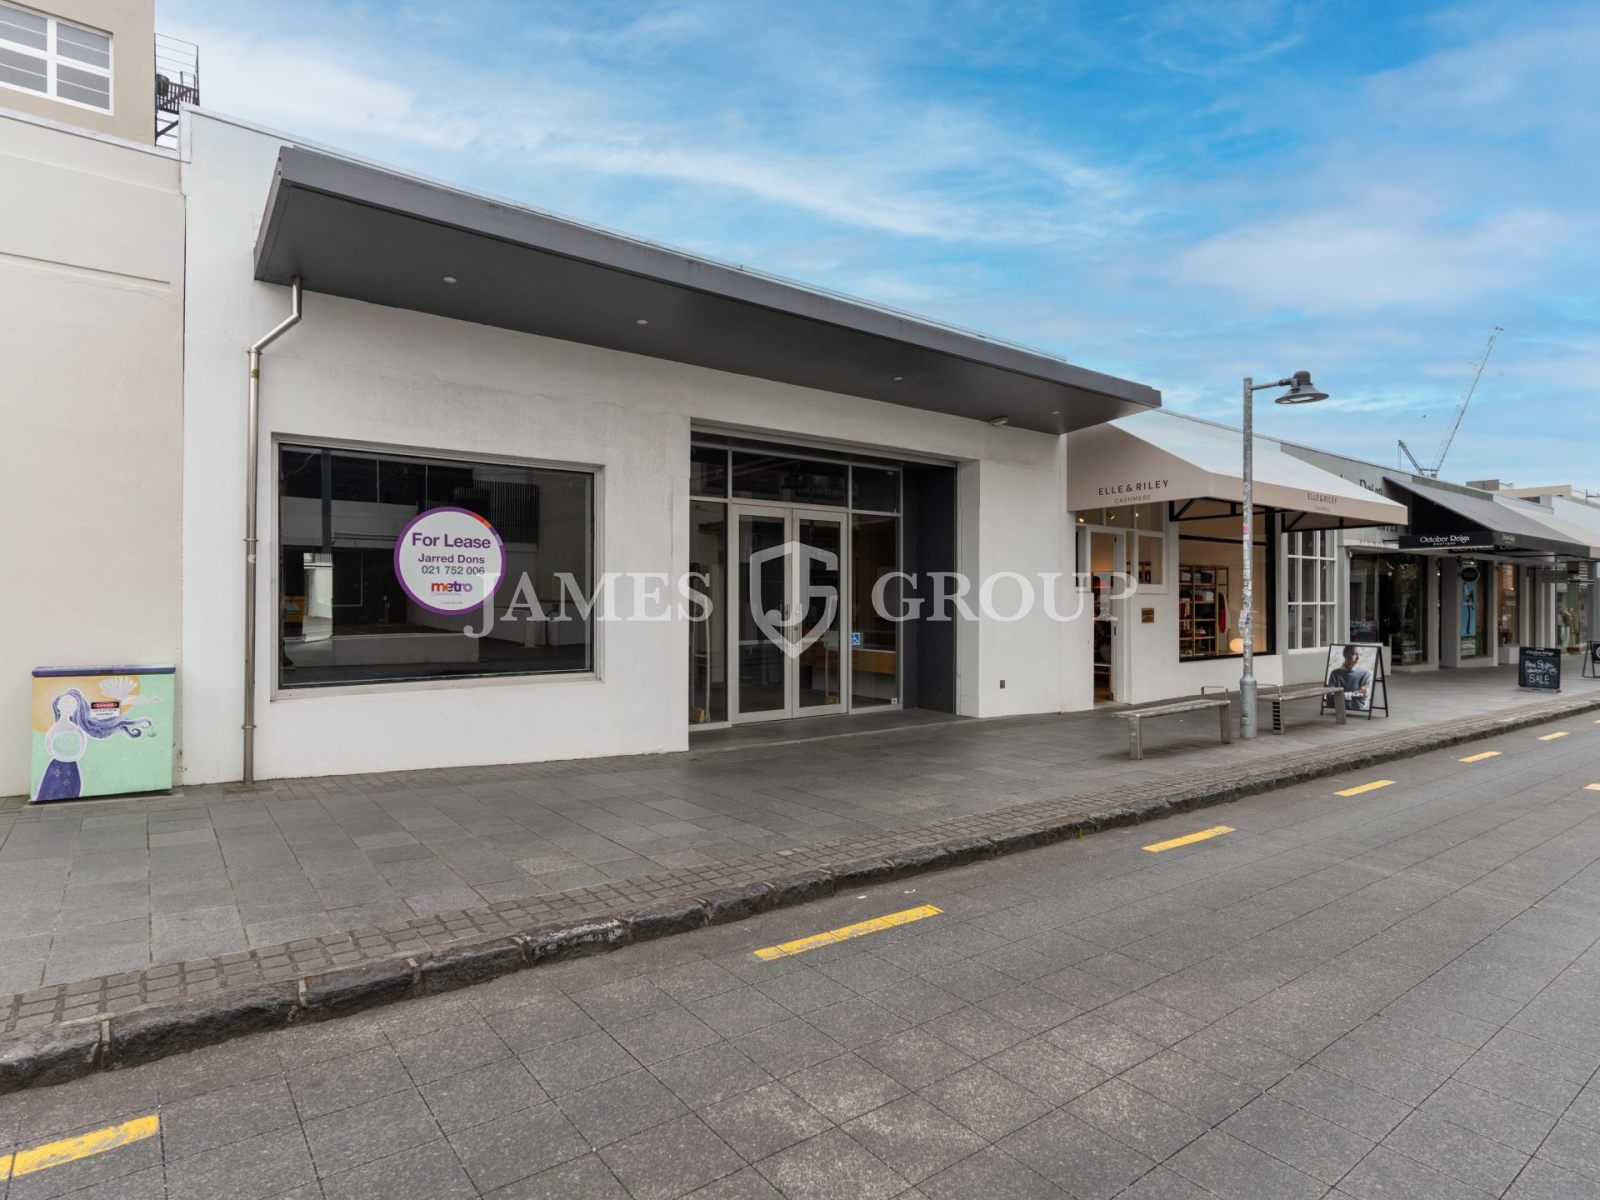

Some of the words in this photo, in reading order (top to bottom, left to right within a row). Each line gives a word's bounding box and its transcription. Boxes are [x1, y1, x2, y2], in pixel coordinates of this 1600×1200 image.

[1114, 495, 1151, 504] CASHMERE
[412, 532, 440, 547] For
[444, 533, 491, 549] Lease
[1420, 535, 1449, 543] October
[1450, 535, 1470, 543] Reign
[418, 553, 454, 564] Jarred
[457, 554, 485, 564] Dons
[422, 565, 440, 575] 021
[445, 566, 463, 575] 752
[466, 566, 485, 576] 006
[431, 580, 473, 592] metro
[1529, 673, 1550, 685] SALE
